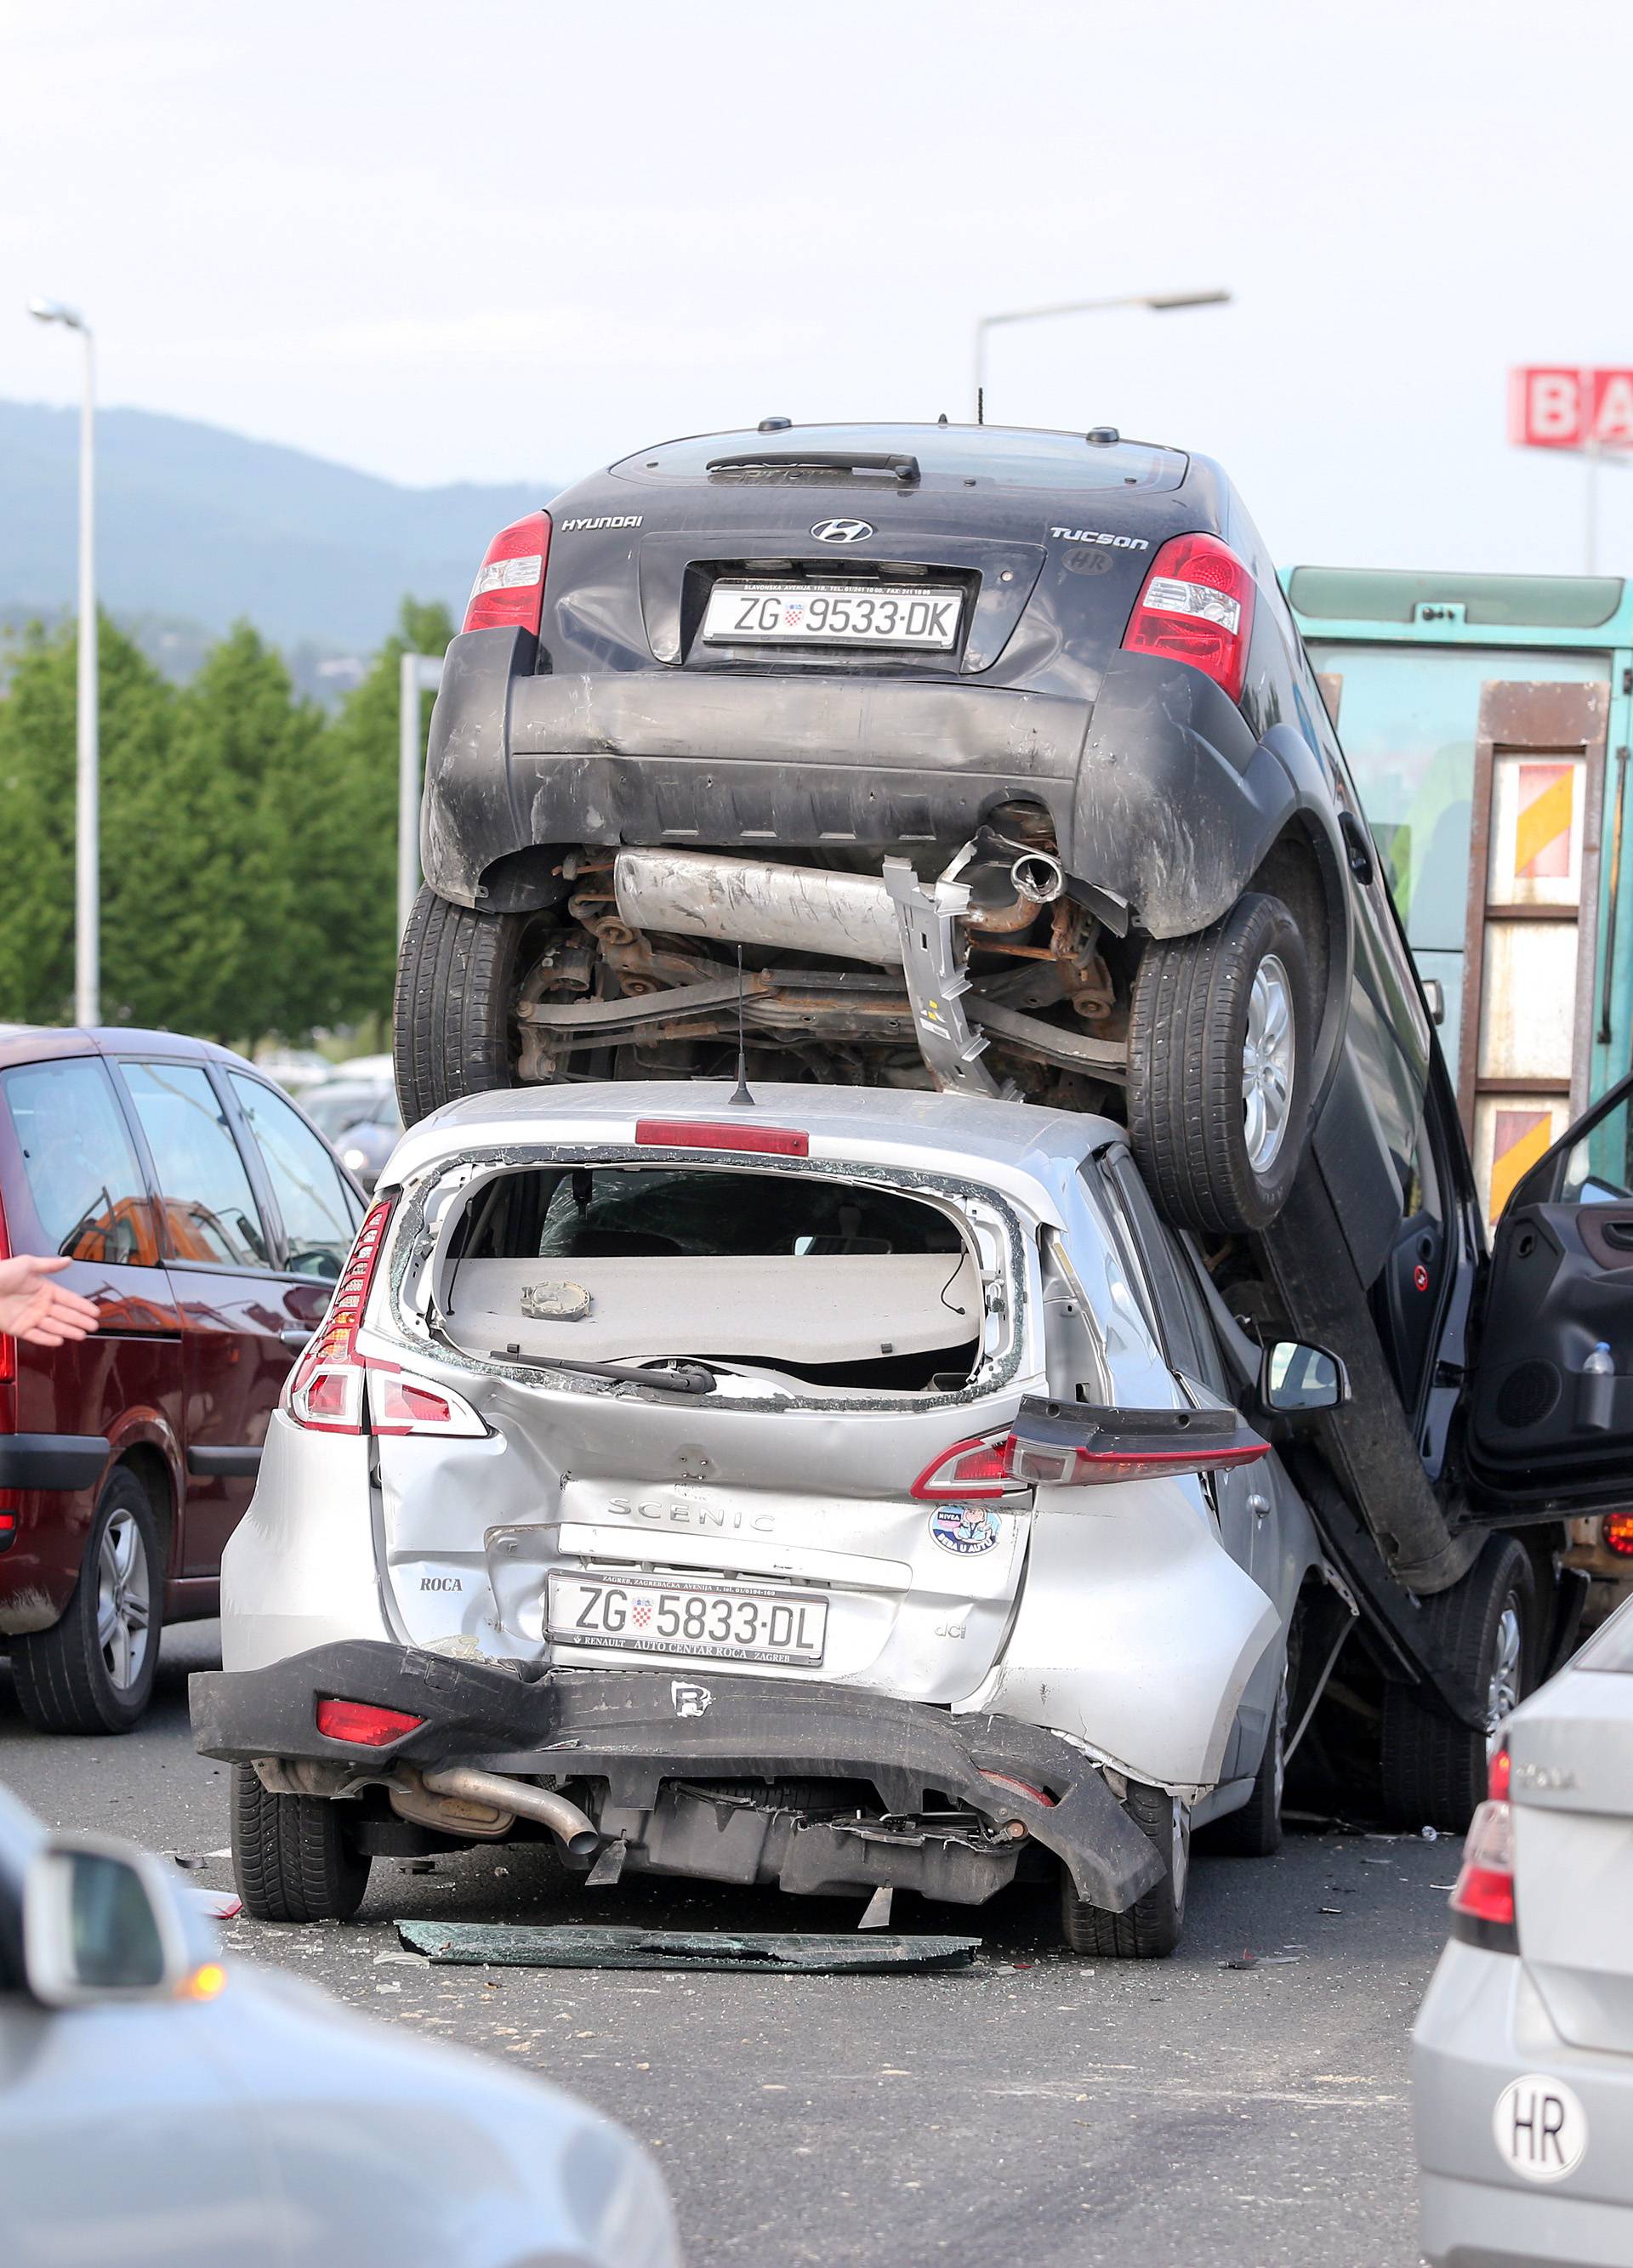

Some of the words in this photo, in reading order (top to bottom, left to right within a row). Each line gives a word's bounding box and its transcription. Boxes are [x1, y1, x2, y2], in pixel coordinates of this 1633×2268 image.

[561, 515, 644, 531] HYUNDAI
[1050, 526, 1149, 550] TUCSON
[1071, 550, 1105, 571] HR
[734, 597, 781, 631] ZG
[607, 1497, 776, 1532] SCENIC
[959, 1543, 967, 1552] U
[420, 1577, 463, 1591] ROCA
[603, 1576, 632, 1584] ZAGREB,
[576, 1587, 628, 1632] ZG
[584, 1635, 625, 1648] RENAULT
[634, 1640, 666, 1651] AUTO
[669, 1643, 714, 1656] CENTAR
[715, 1647, 747, 1659] ROCA
[754, 1651, 790, 1663] ZAGREB
[1511, 2088, 1565, 2164] HR
